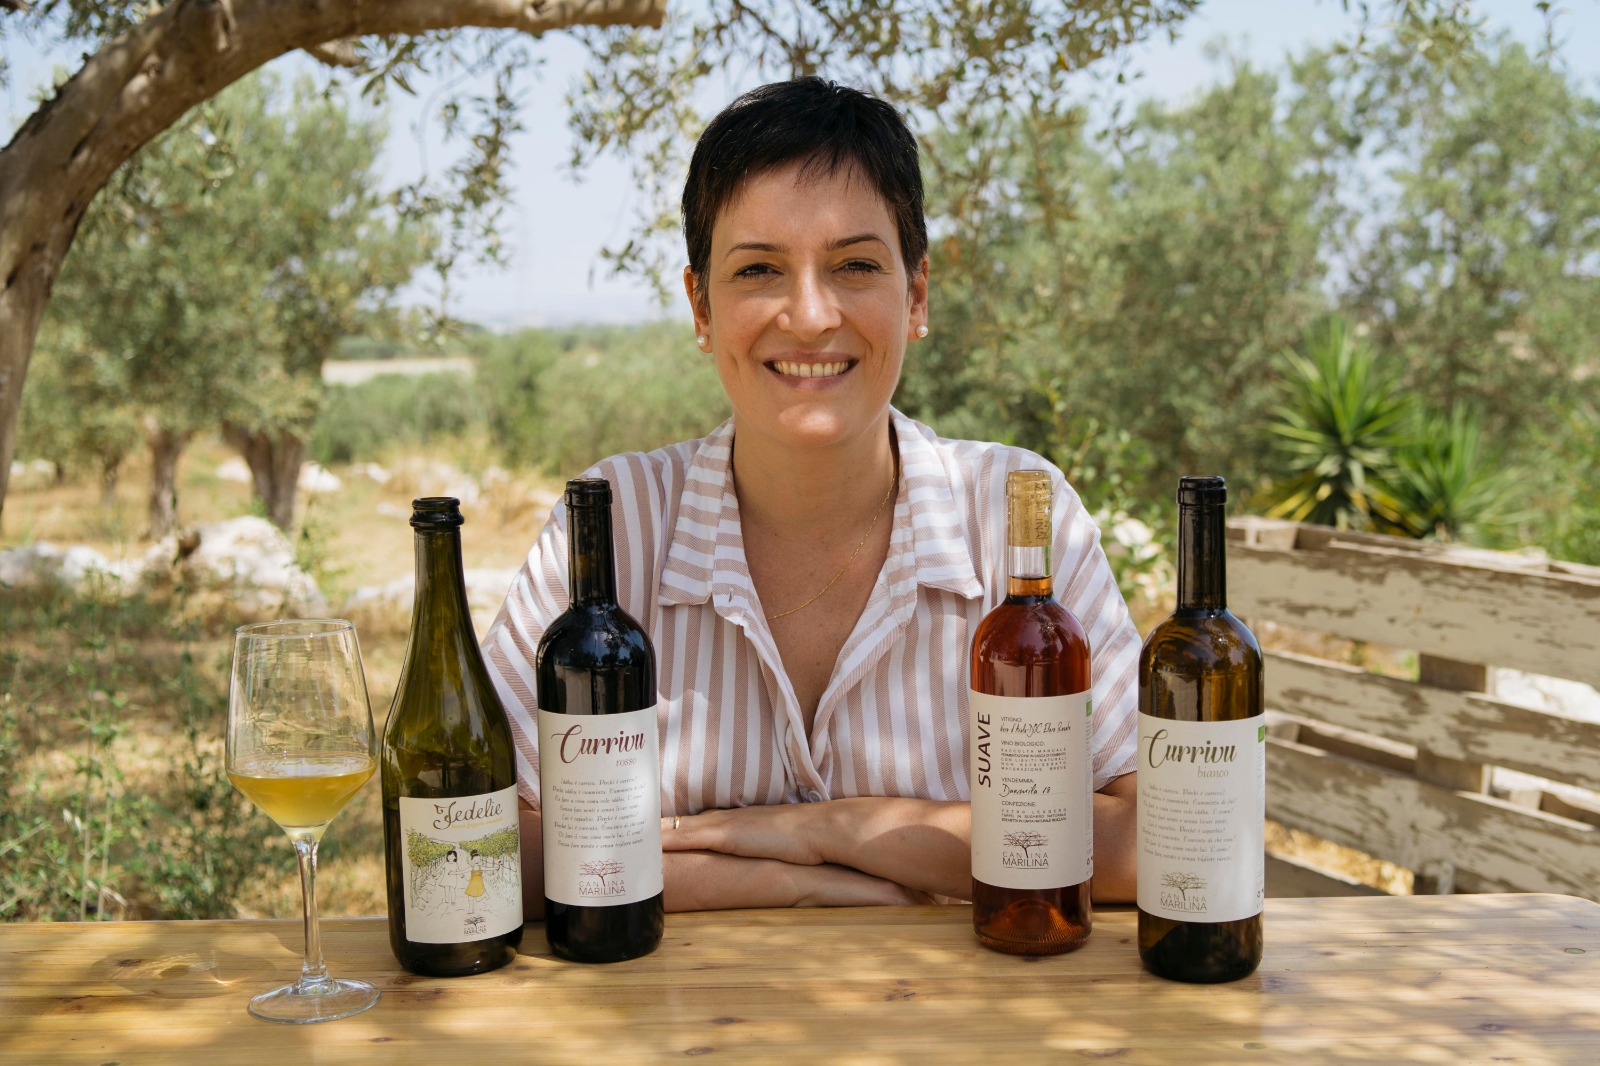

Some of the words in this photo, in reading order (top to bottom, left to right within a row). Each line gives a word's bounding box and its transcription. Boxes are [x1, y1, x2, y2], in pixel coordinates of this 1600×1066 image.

[551, 724, 645, 764] Currivu
[978, 712, 991, 788] SUAVE
[1143, 729, 1237, 768] Currivu
[1003, 858, 1049, 866] MARILINA
[579, 886, 625, 895] MARILINA
[1160, 898, 1207, 911] MARILINA
